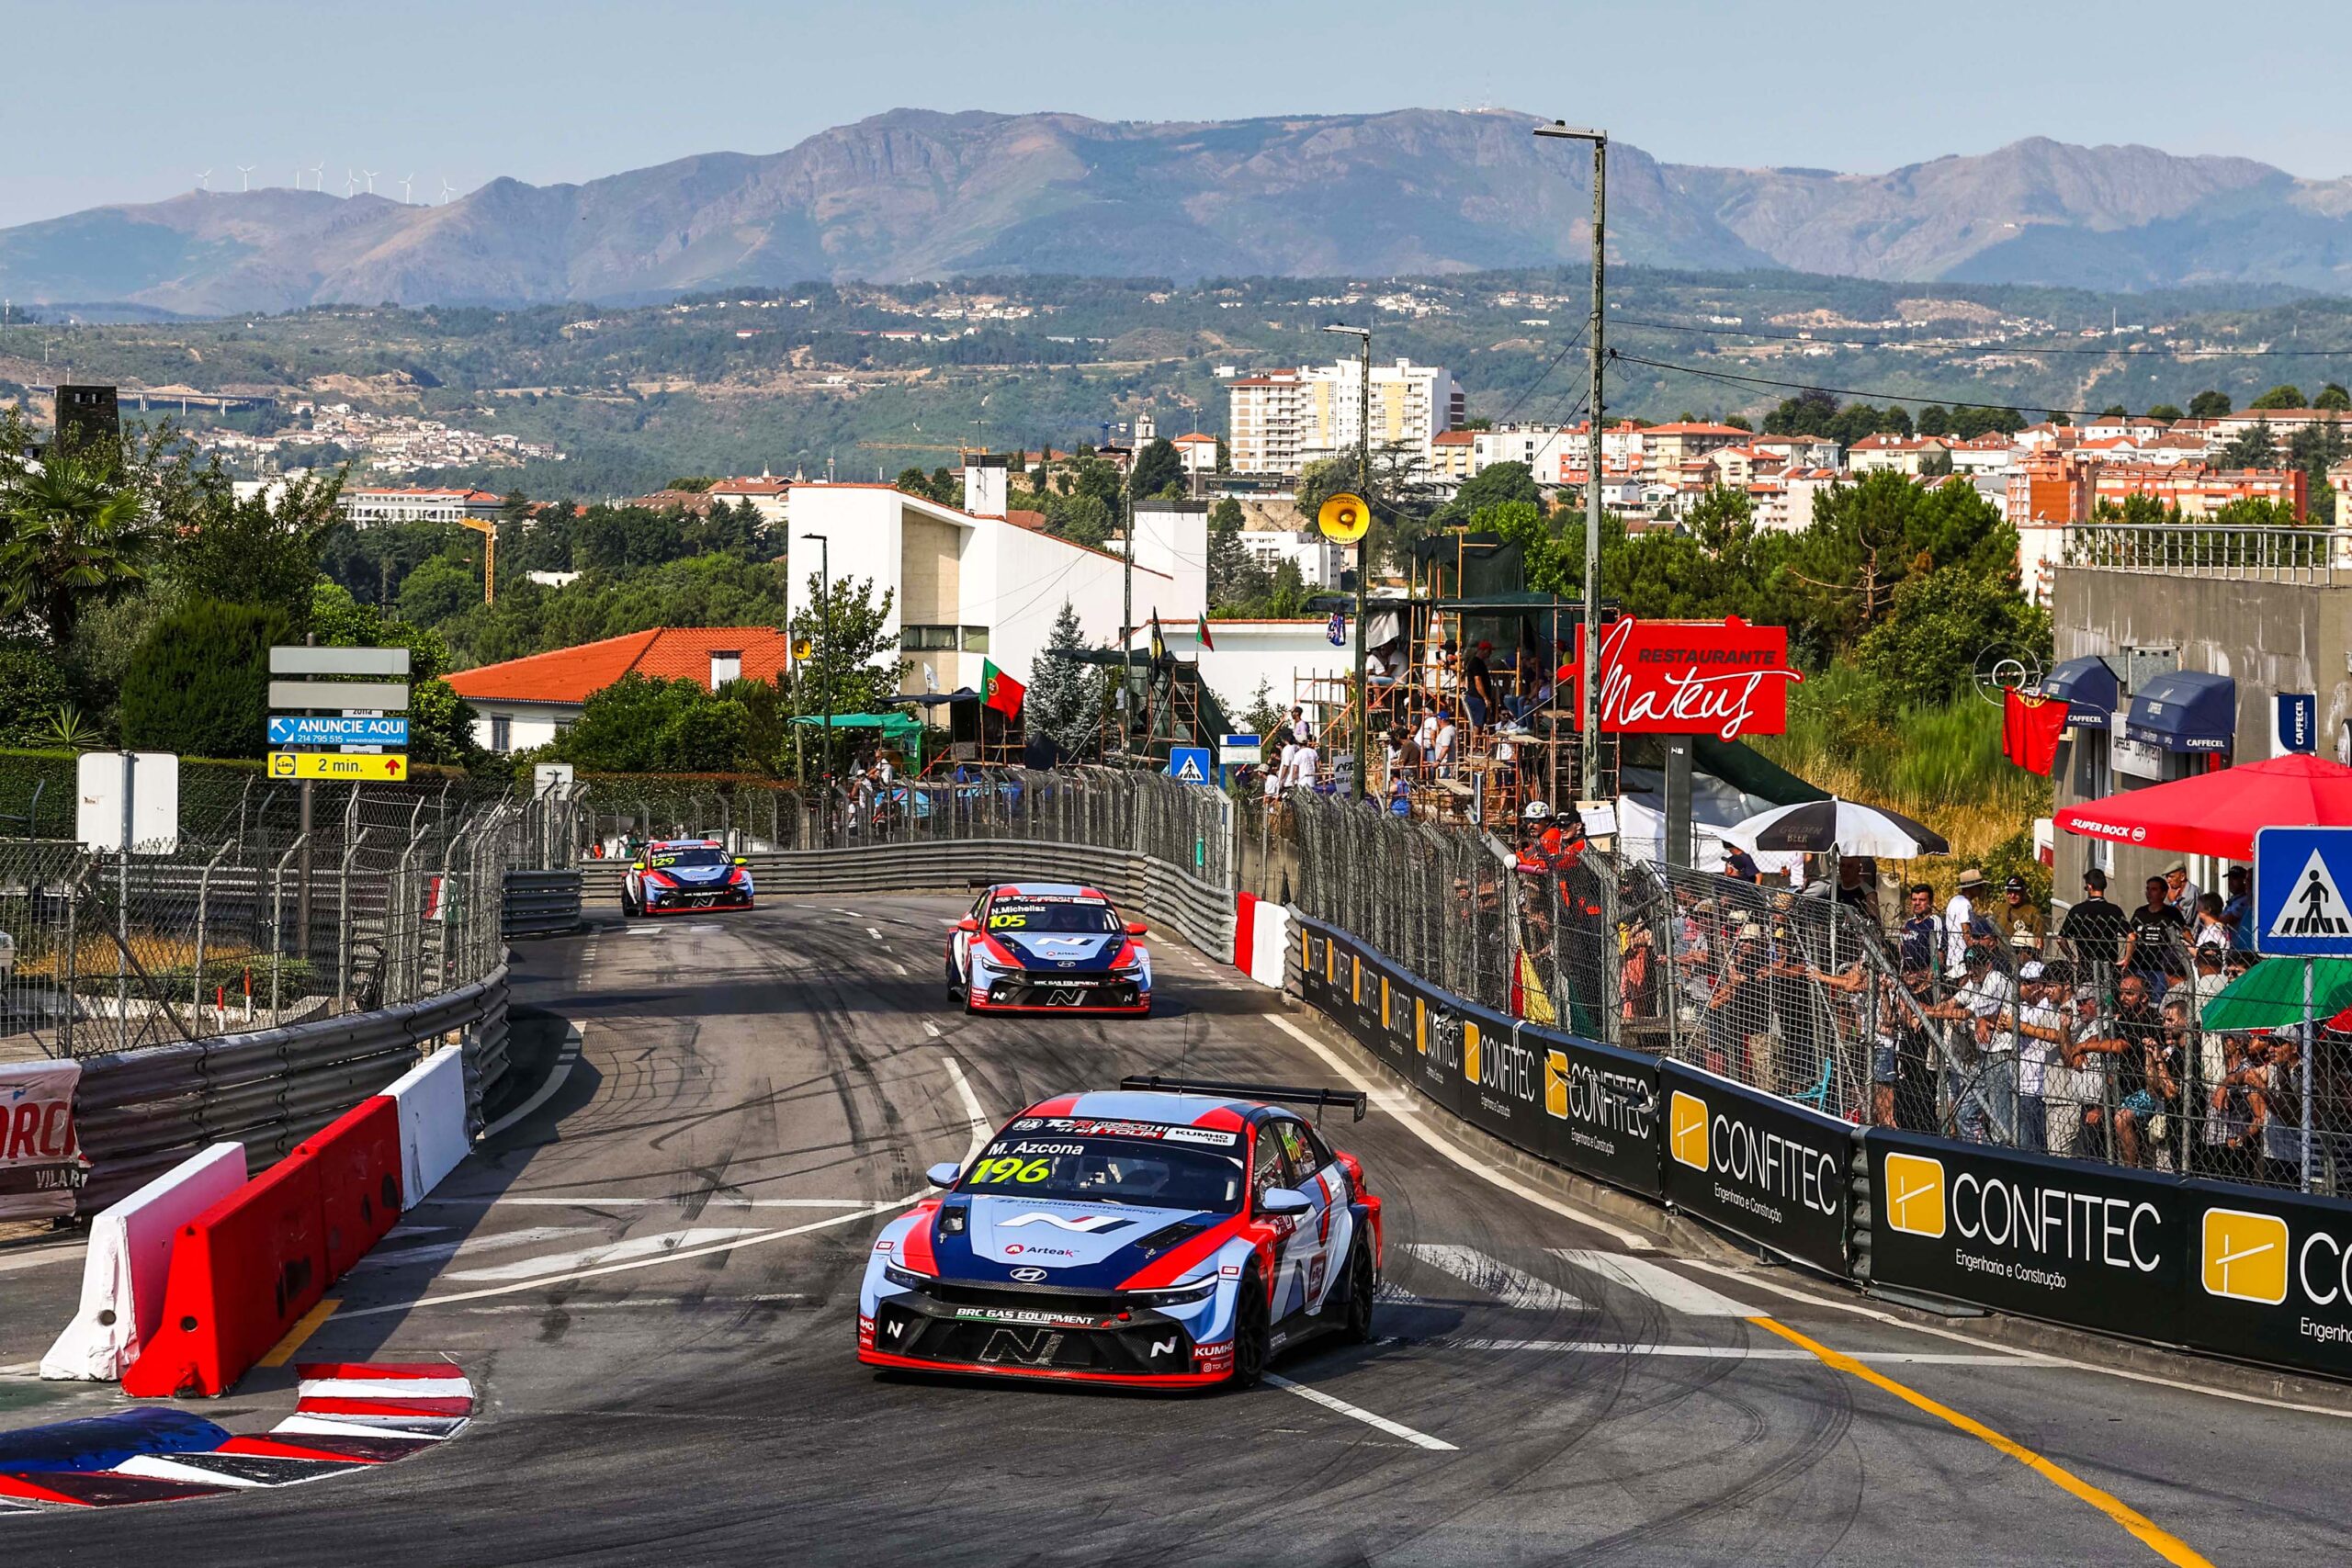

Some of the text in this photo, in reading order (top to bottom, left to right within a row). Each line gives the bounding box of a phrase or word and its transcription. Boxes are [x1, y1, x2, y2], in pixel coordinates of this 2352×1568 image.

[1638, 649, 1777, 665] RESTAURANTE
[298, 720, 404, 735] ANUNCIE AQUI
[298, 735, 311, 743] 214
[312, 735, 327, 743] 795
[329, 735, 343, 743] 515
[318, 759, 327, 772] 2
[333, 759, 363, 773] min.
[2070, 818, 2102, 832] SUPER
[2102, 824, 2130, 837] BOCK
[1787, 834, 1808, 843] BEER
[651, 857, 675, 867] 129
[989, 914, 1026, 929] 105
[1480, 1033, 1535, 1102] CONFITEC
[1013, 1119, 1040, 1130] FIA
[1046, 1119, 1096, 1129] TCR
[1105, 1128, 1159, 1137] TOUR
[1175, 1130, 1228, 1140] KUMHO
[987, 1141, 1084, 1156] M. Azcona
[969, 1157, 1050, 1185] 196
[1713, 1113, 1837, 1216] CONFITEC
[1714, 1182, 1745, 1210] Engenharia
[1750, 1198, 1782, 1224] Construção
[1952, 1172, 2162, 1272] CONFITEC
[1955, 1247, 2066, 1291] Engenharia e Construção
[956, 1308, 1094, 1325] BRC GAS EQUIPMENT
[1194, 1341, 1234, 1357] KUMHO
